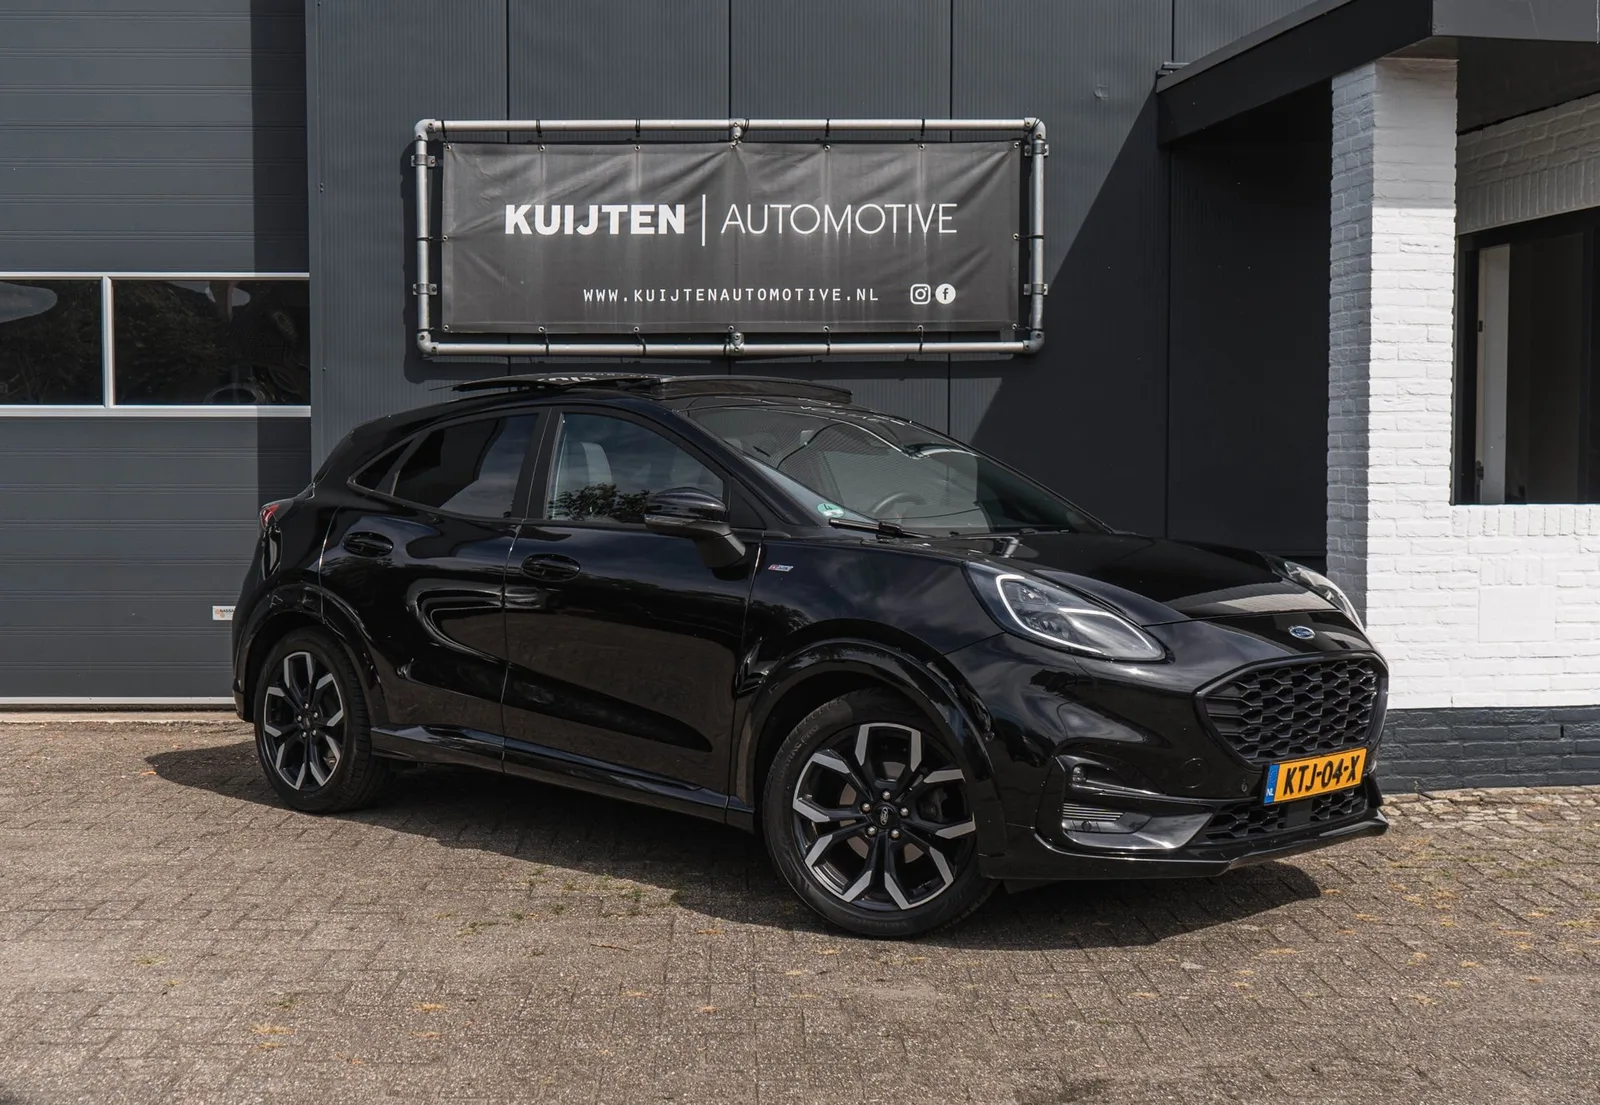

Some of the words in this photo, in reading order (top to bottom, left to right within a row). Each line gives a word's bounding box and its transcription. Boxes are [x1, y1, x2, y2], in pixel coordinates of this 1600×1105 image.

[505, 204, 685, 236] KUIJTEN
[721, 203, 958, 235] AUTOMOTIVE
[583, 288, 879, 302] WWW.KUIJTENAUTOMOTIVE.NL
[1283, 755, 1360, 796] KTJ-04-X
[1265, 787, 1275, 797] NL
